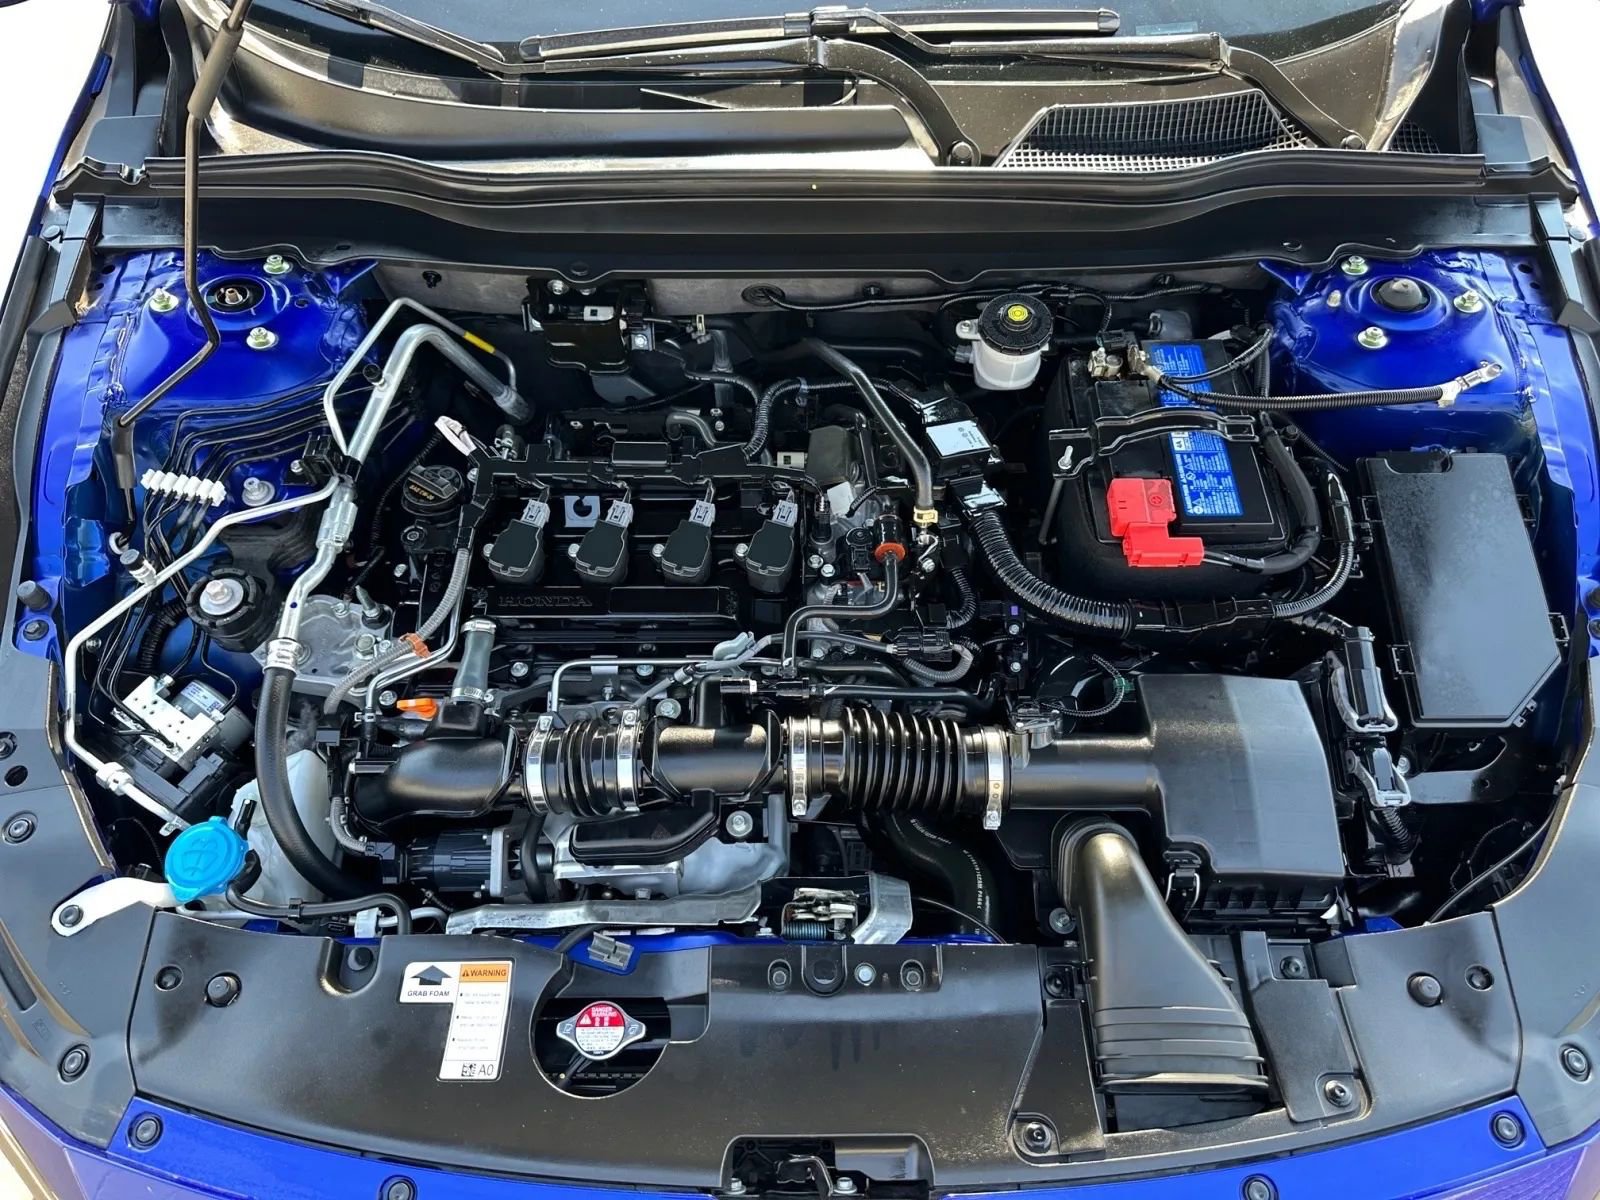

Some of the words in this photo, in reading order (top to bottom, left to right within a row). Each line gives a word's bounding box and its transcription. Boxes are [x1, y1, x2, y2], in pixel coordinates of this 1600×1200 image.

[498, 595, 593, 607] HONDA
[470, 969, 507, 977] WARNING
[477, 1064, 495, 1077] A0
